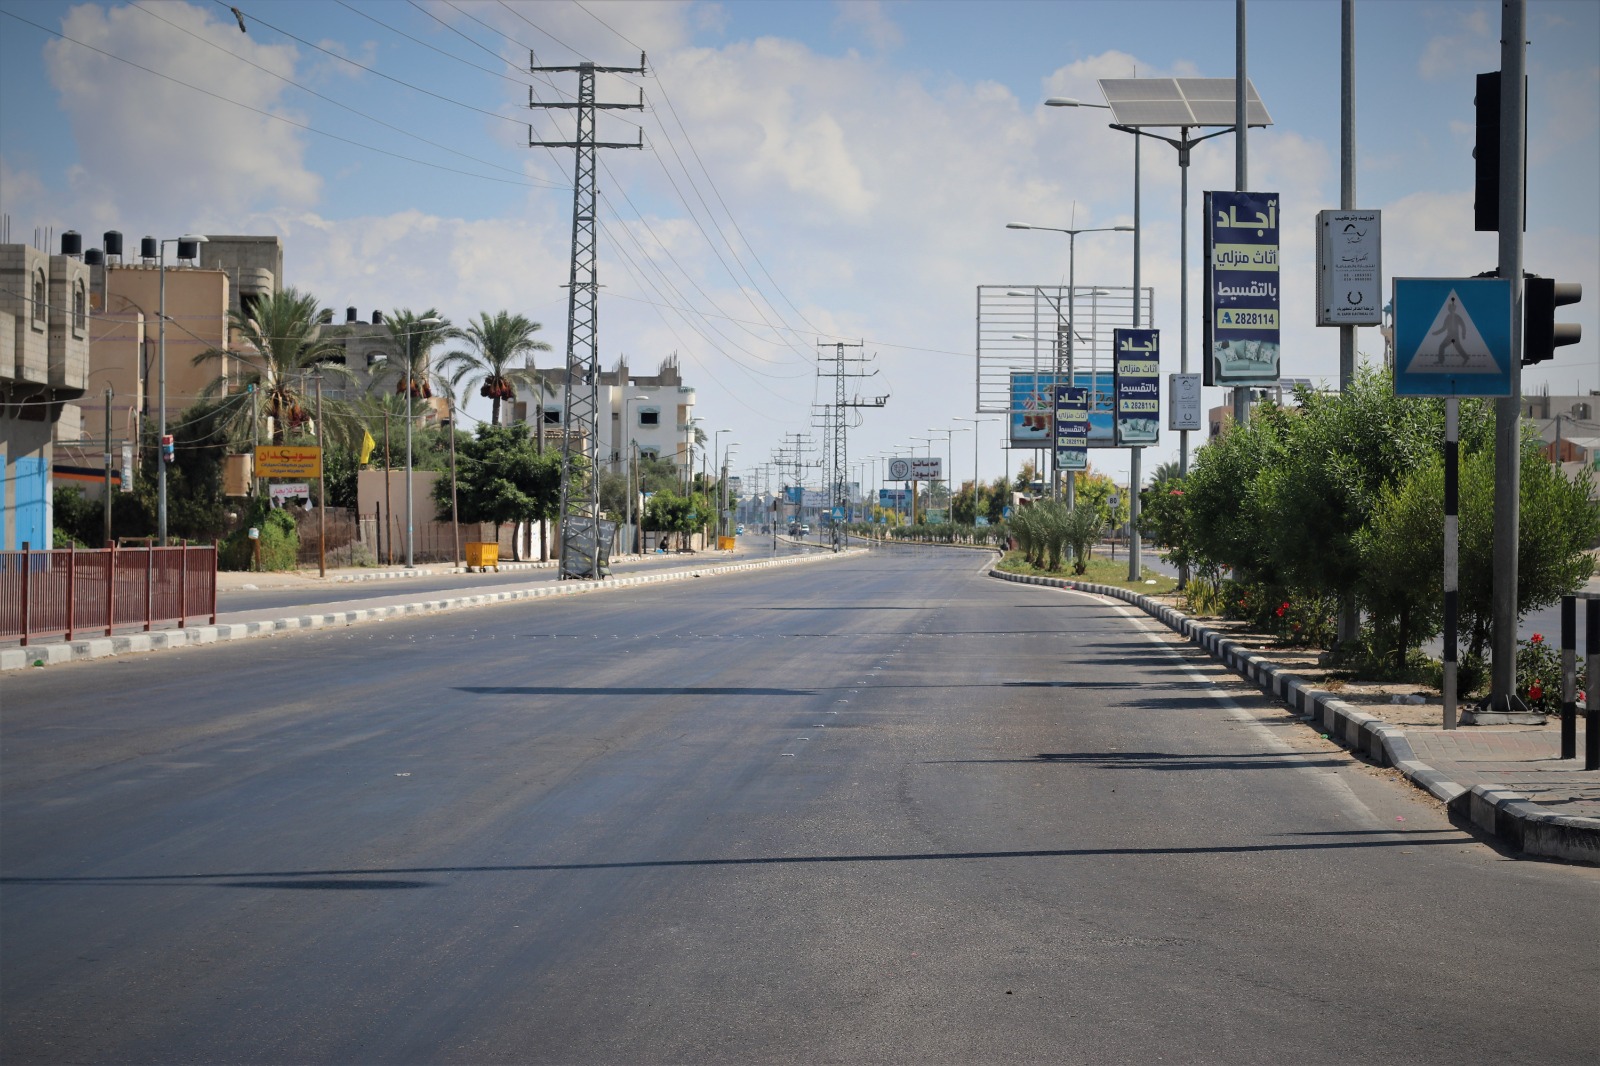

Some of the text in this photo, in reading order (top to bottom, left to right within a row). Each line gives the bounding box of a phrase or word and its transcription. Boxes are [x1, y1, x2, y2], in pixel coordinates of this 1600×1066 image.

[1216, 199, 1277, 237] آجاد
[1216, 250, 1249, 267] منزلي
[1217, 280, 1277, 301] بالتقسيط
[1235, 312, 1274, 325] 2828114
[1120, 363, 1140, 375] منزلي
[1120, 382, 1157, 395] بالتقسيط
